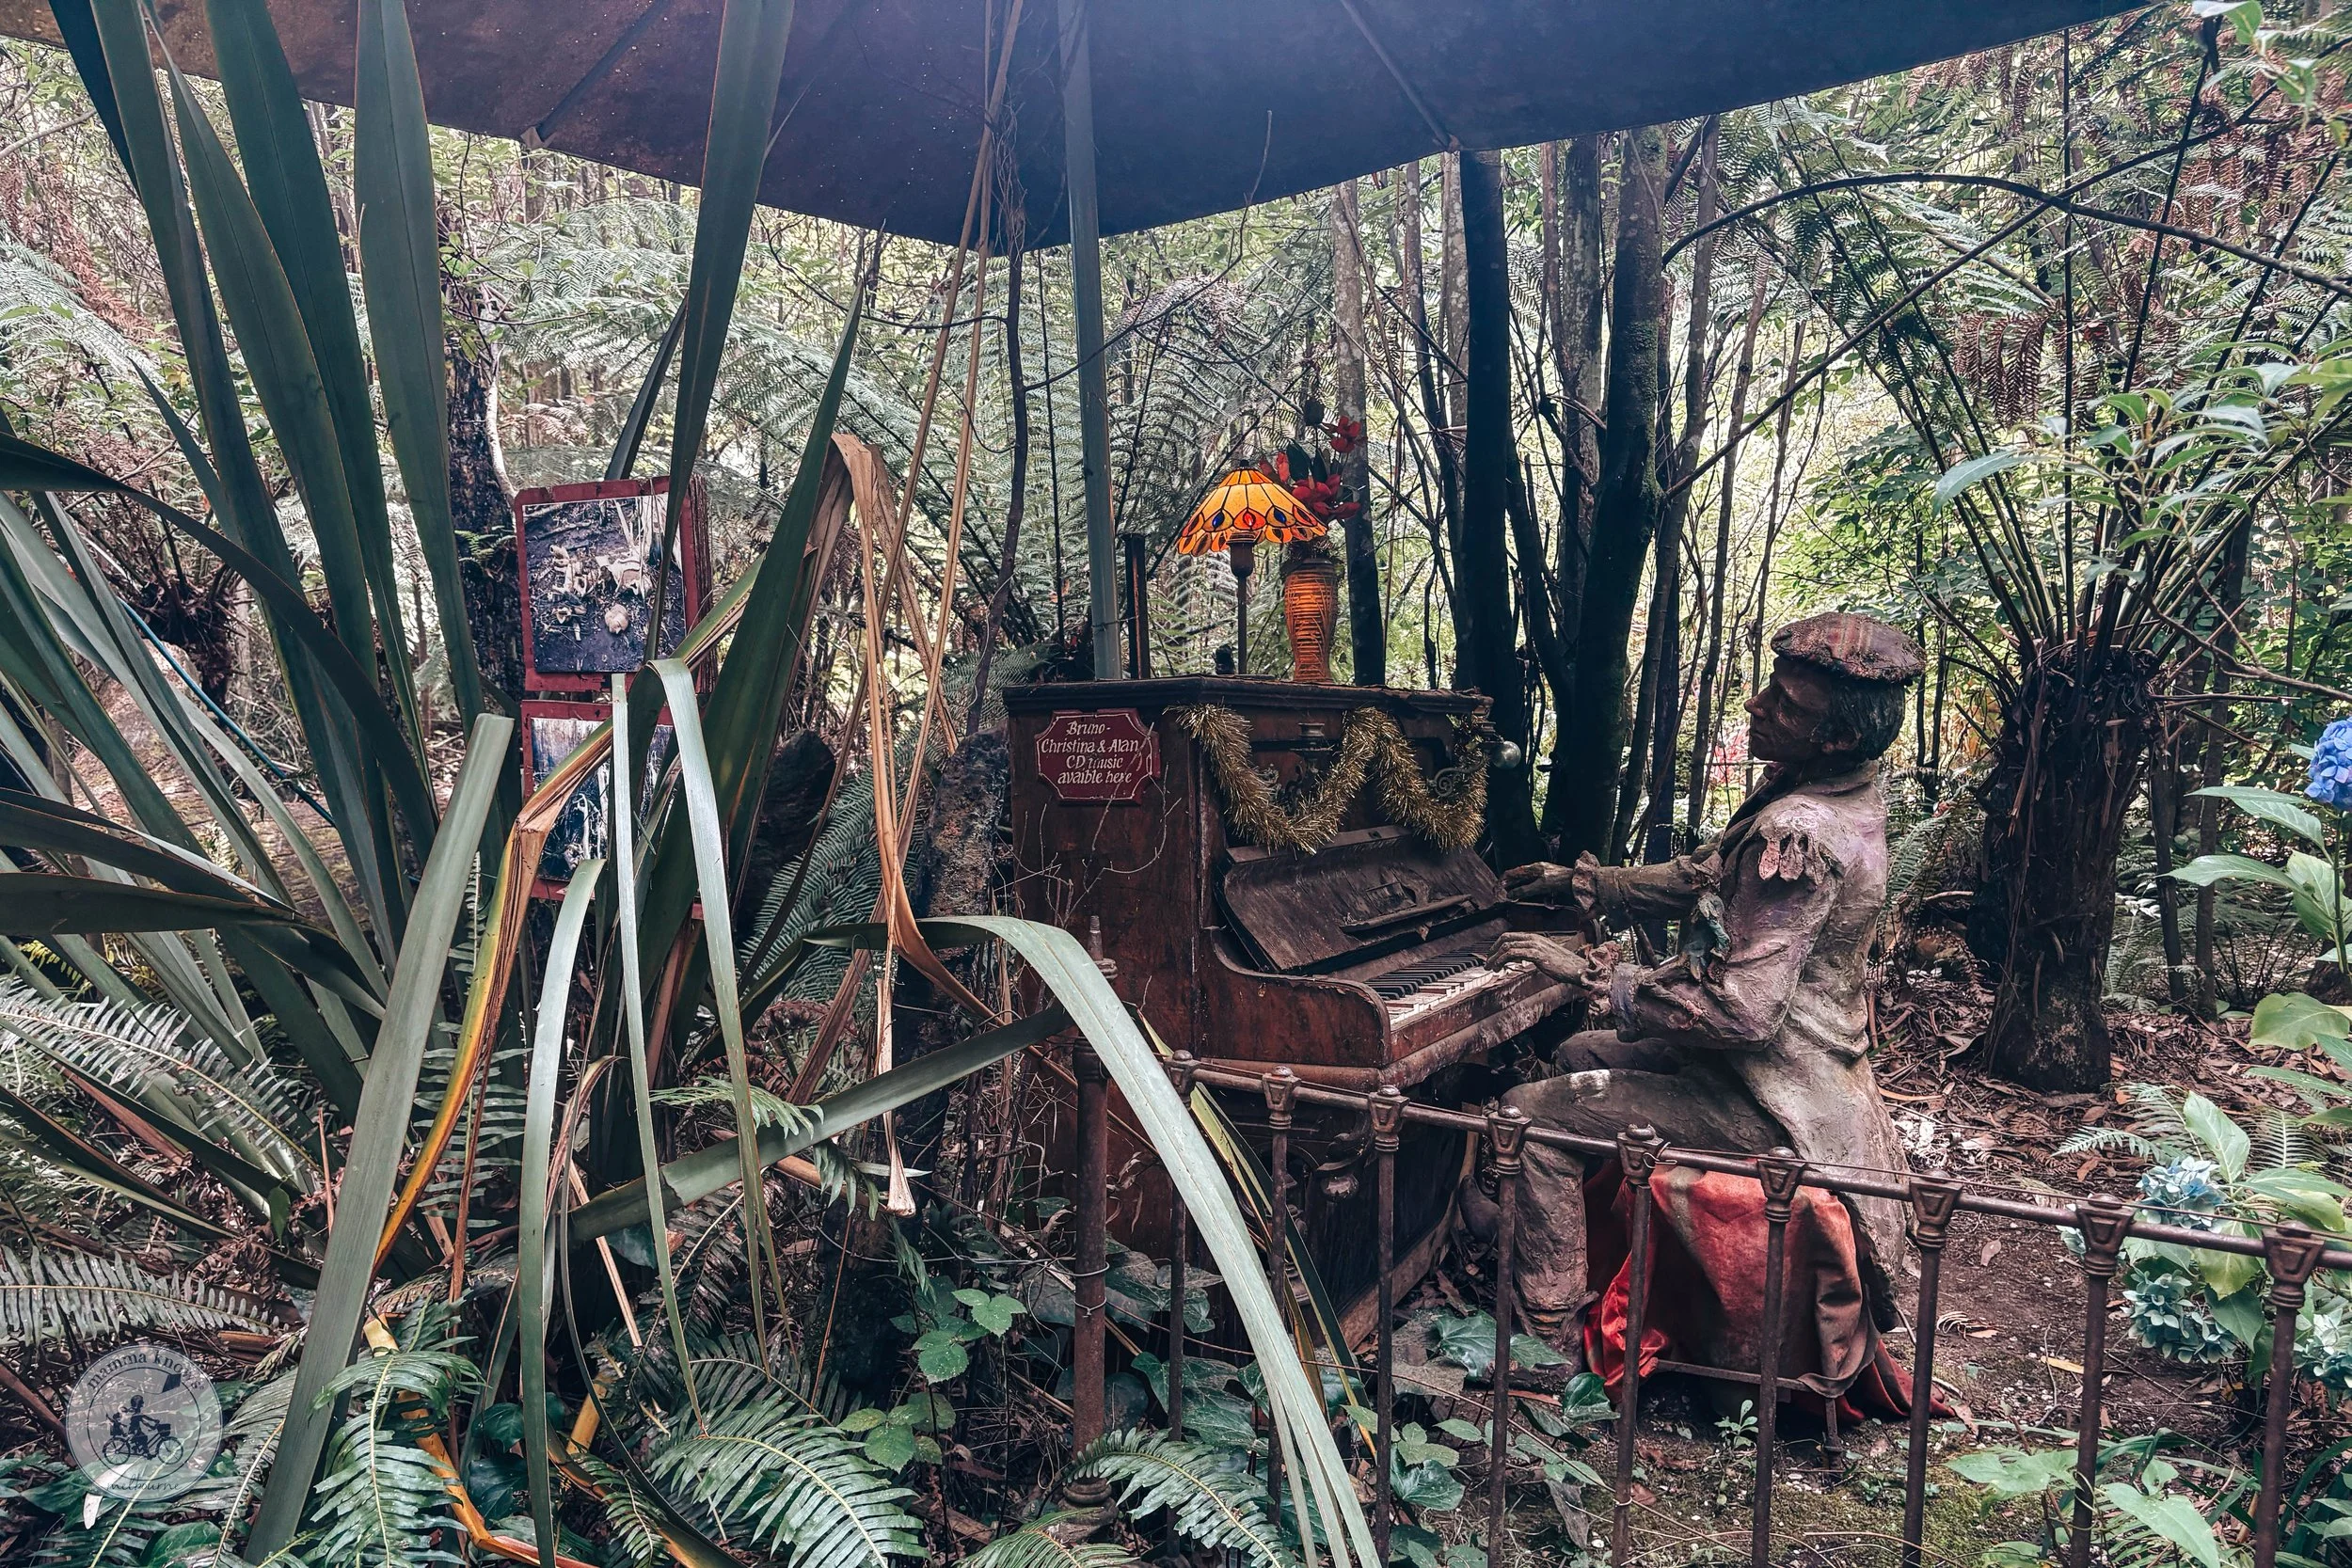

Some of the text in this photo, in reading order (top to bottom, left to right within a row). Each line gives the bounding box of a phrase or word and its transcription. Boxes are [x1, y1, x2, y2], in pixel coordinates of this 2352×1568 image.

[1041, 738, 1139, 752] Christina & Alan
[1066, 754, 1123, 769] CD music
[1104, 769, 1133, 784] here
